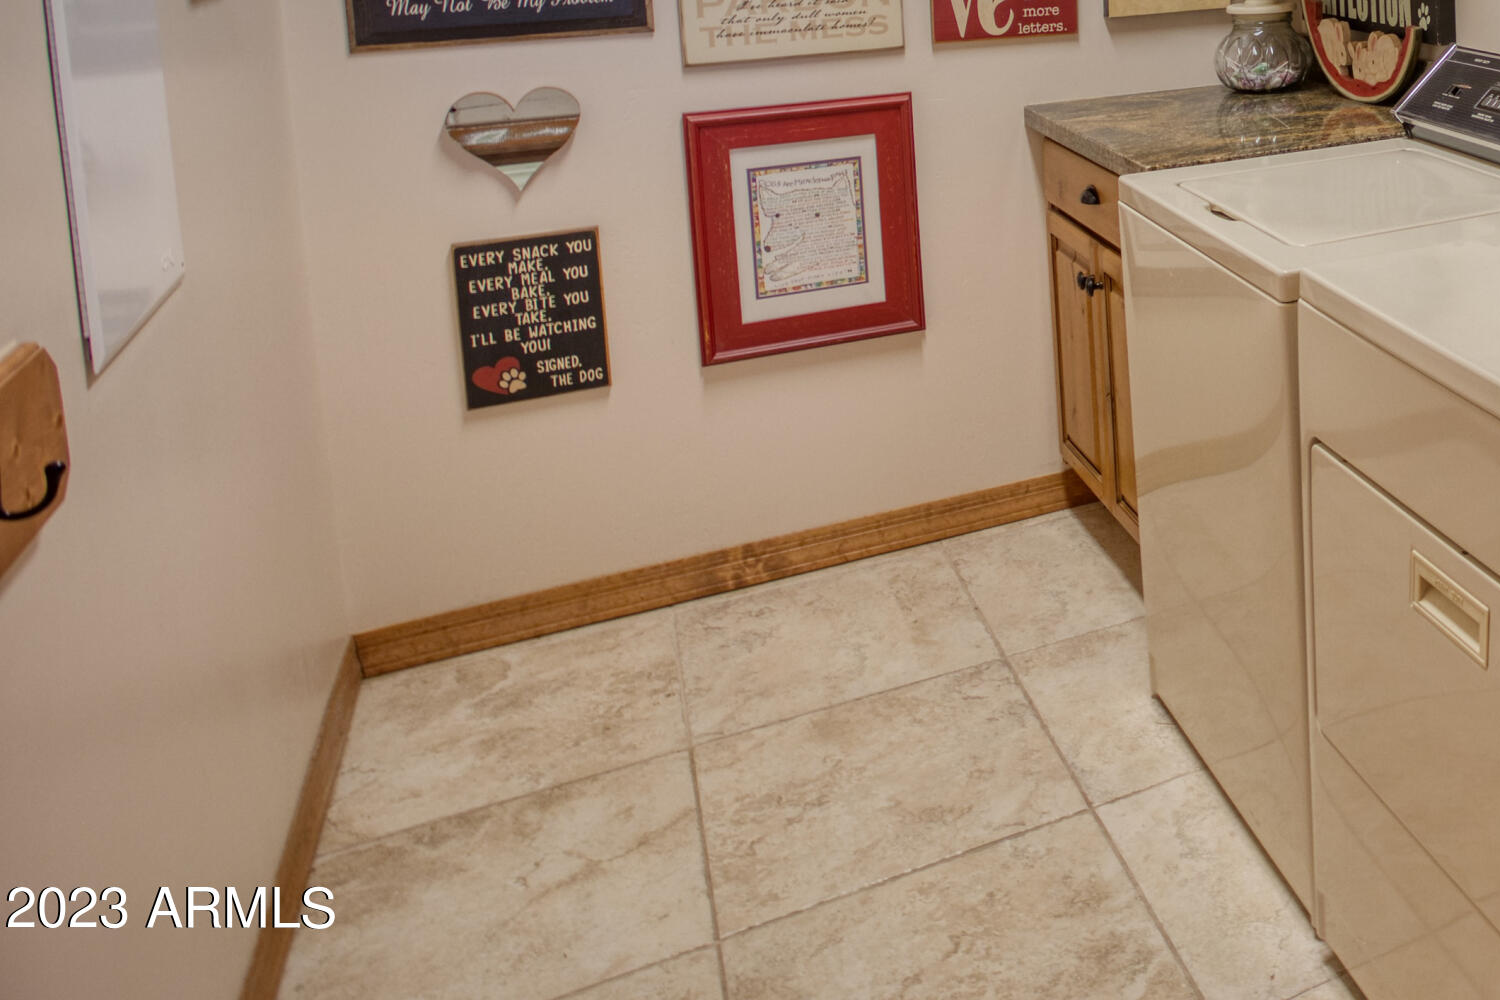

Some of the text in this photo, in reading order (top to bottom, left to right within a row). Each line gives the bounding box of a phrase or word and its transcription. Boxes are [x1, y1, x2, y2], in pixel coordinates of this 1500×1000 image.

[1022, 6, 1060, 17] more
[699, 15, 889, 48] THE MESS
[1018, 23, 1067, 34] letters.
[460, 239, 592, 268] EVERY SNACK YOU
[469, 265, 588, 294] EVERY MEAL YOU
[473, 290, 589, 319] EVERY BITE YOU
[470, 317, 597, 347] I'LL BE WATCHING
[551, 368, 603, 387] THE DOG
